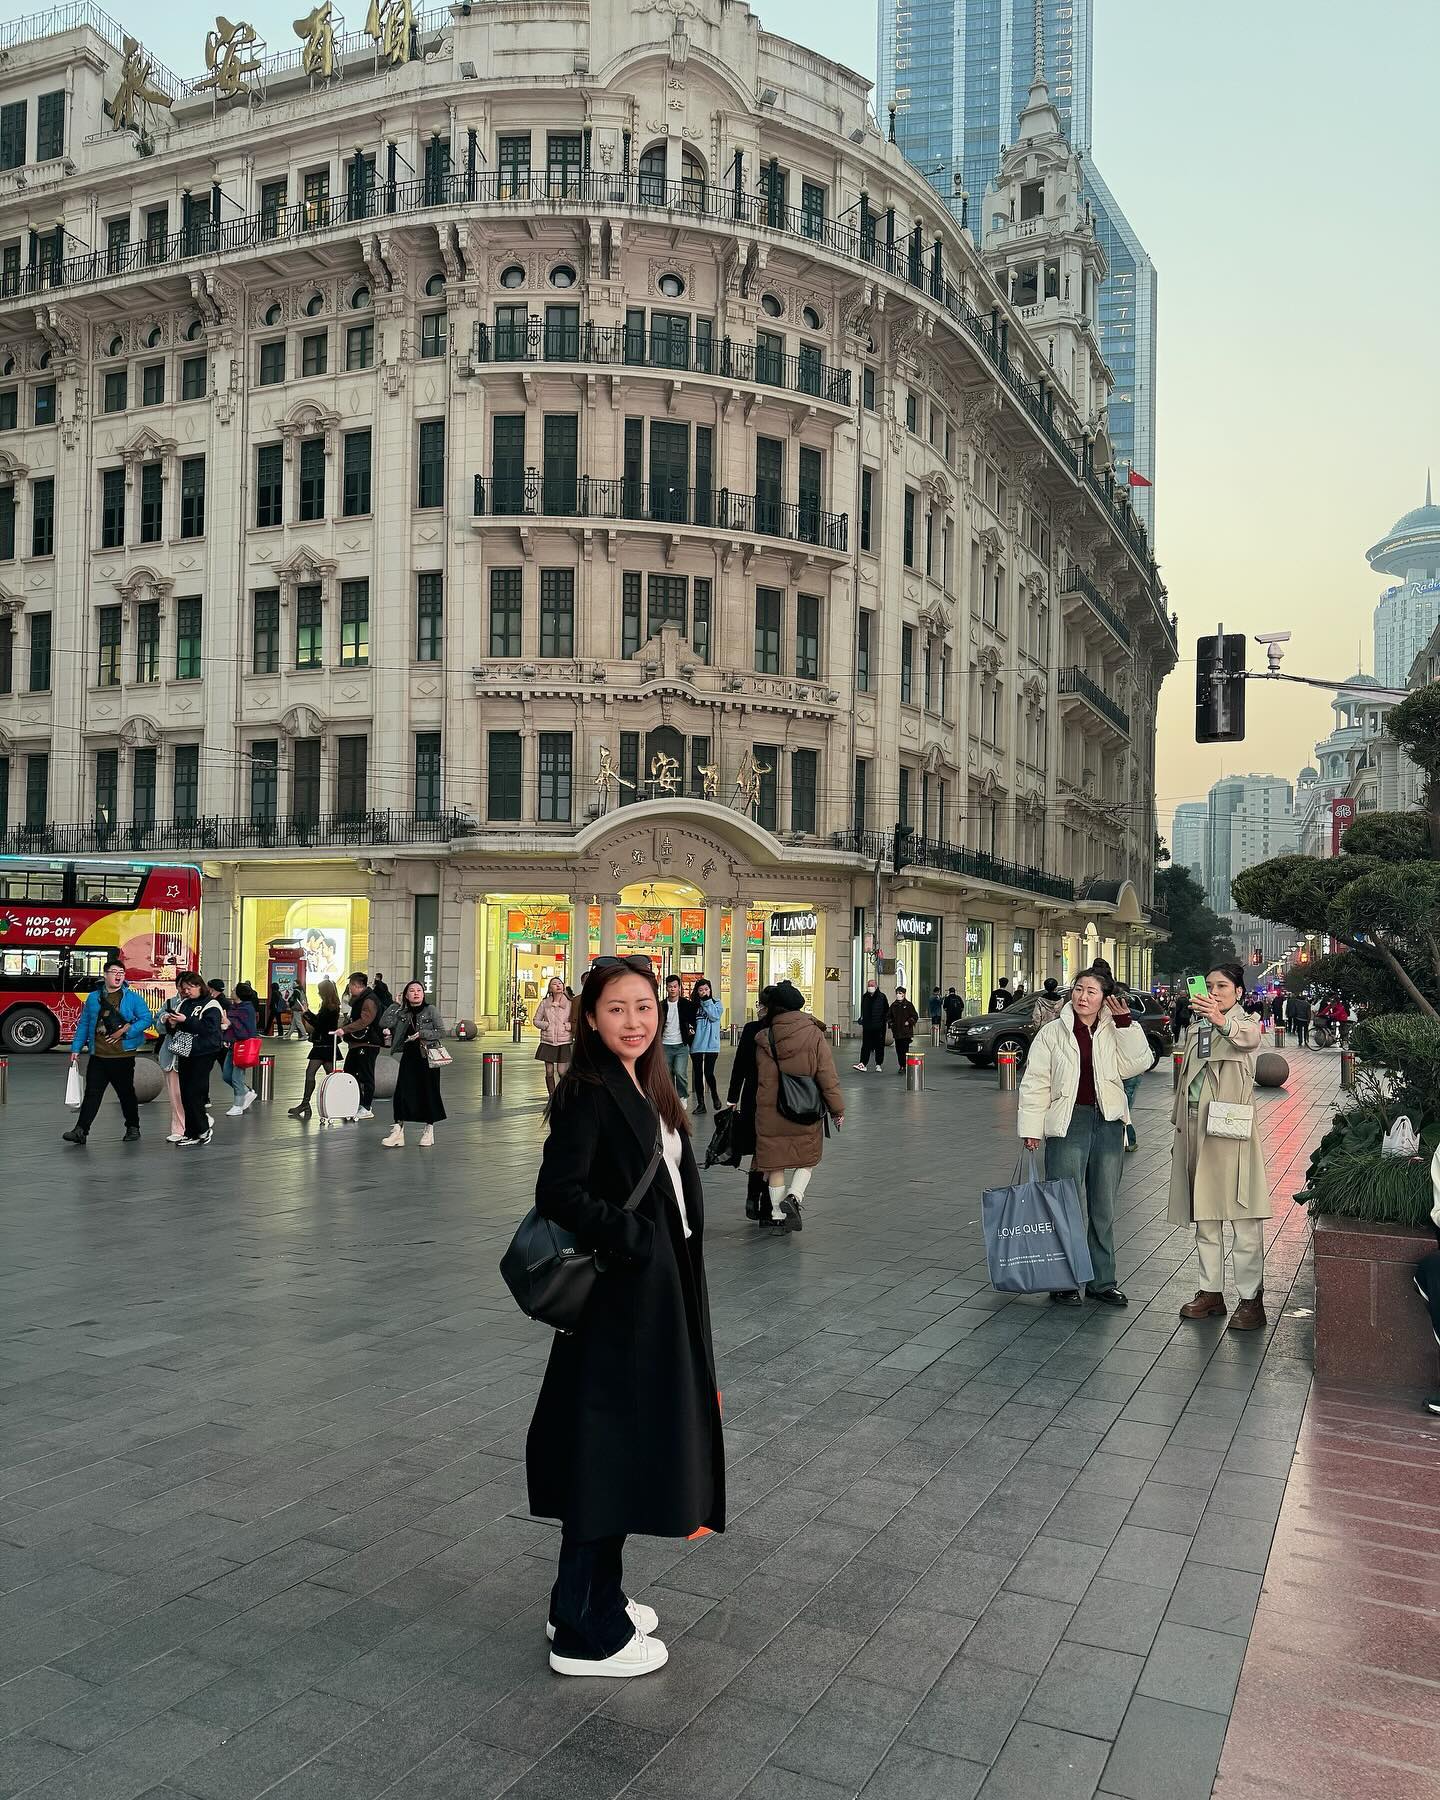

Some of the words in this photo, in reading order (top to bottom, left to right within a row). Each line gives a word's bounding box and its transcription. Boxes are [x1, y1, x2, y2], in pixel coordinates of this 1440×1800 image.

[1410, 578, 1440, 596] Radi
[25, 916, 71, 927] HOP-ON
[25, 927, 77, 937] HOP-OFF
[997, 1225, 1022, 1237] LOVE
